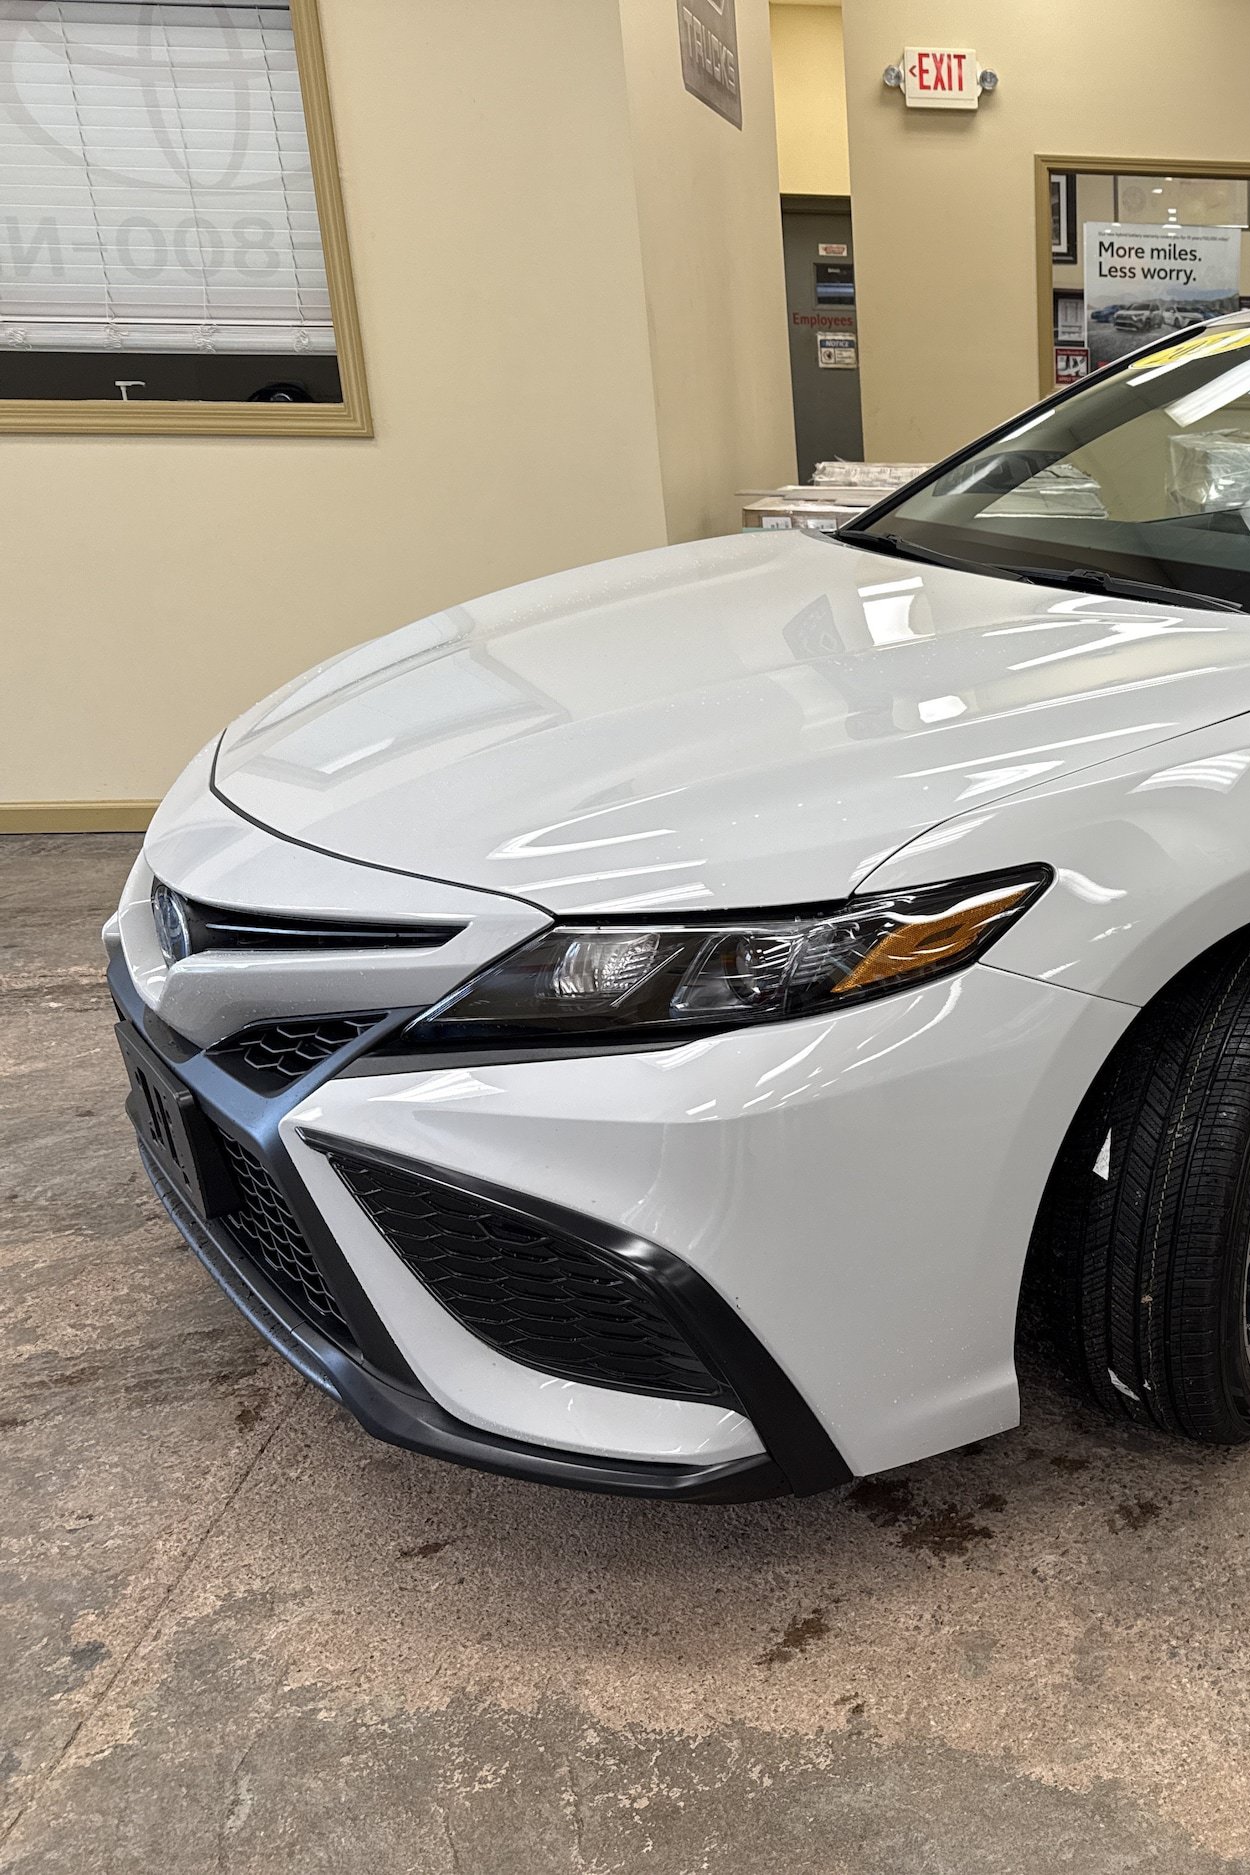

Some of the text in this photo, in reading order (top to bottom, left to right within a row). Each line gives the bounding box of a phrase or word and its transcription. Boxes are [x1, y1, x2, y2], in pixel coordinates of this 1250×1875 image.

[681, 4, 737, 96] TRUCKS
[918, 52, 967, 92] EXIT
[1098, 241, 1202, 262] More miles.
[1098, 261, 1197, 285] Less worry.
[792, 312, 853, 328] Employees
